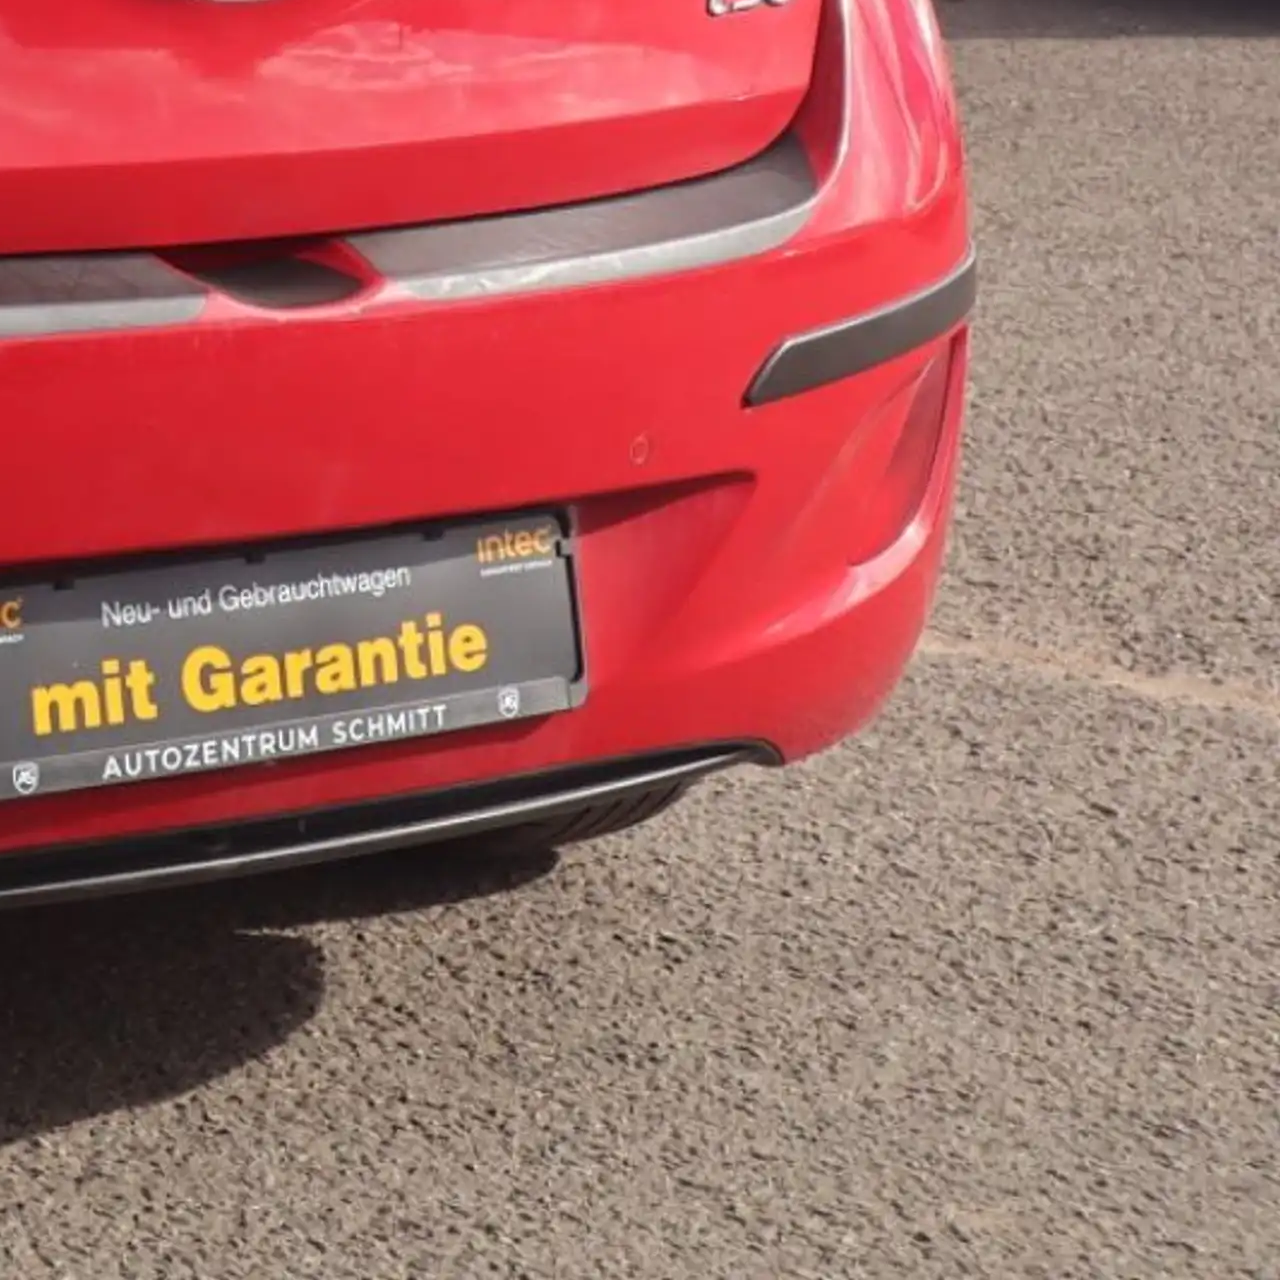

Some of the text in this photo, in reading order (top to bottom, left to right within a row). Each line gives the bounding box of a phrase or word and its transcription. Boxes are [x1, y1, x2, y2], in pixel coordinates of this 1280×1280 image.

[100, 566, 412, 628] Neu- und Gebrauchtwagen
[31, 612, 489, 736] mit Garantie
[102, 704, 448, 781] AUTOZENTRUM SCHMITT
